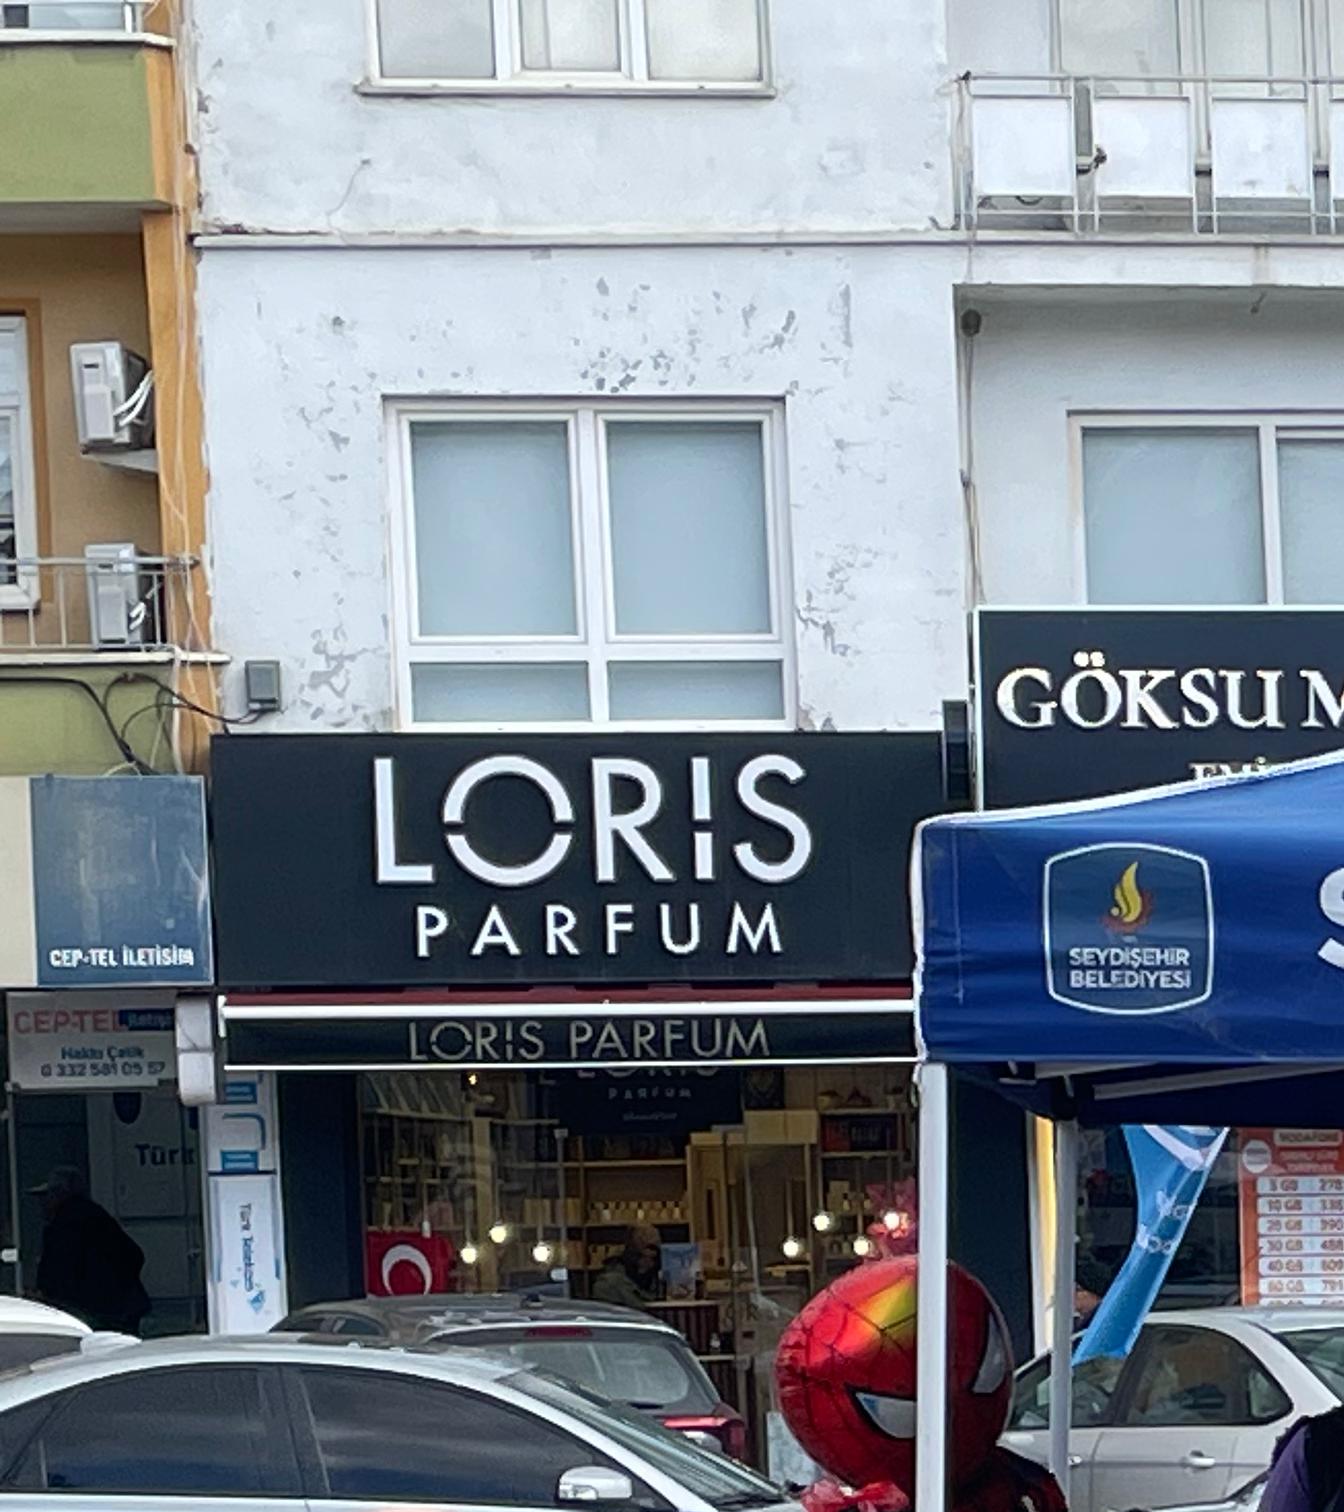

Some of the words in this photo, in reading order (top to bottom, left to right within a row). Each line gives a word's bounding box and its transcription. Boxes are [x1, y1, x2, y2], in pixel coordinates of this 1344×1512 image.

[997, 650, 1285, 730] GÖKSU
[373, 754, 813, 887] LORIS
[415, 903, 784, 959] PARFUM
[409, 1020, 546, 1061] LORIS
[570, 1017, 771, 1059] PARFUM
